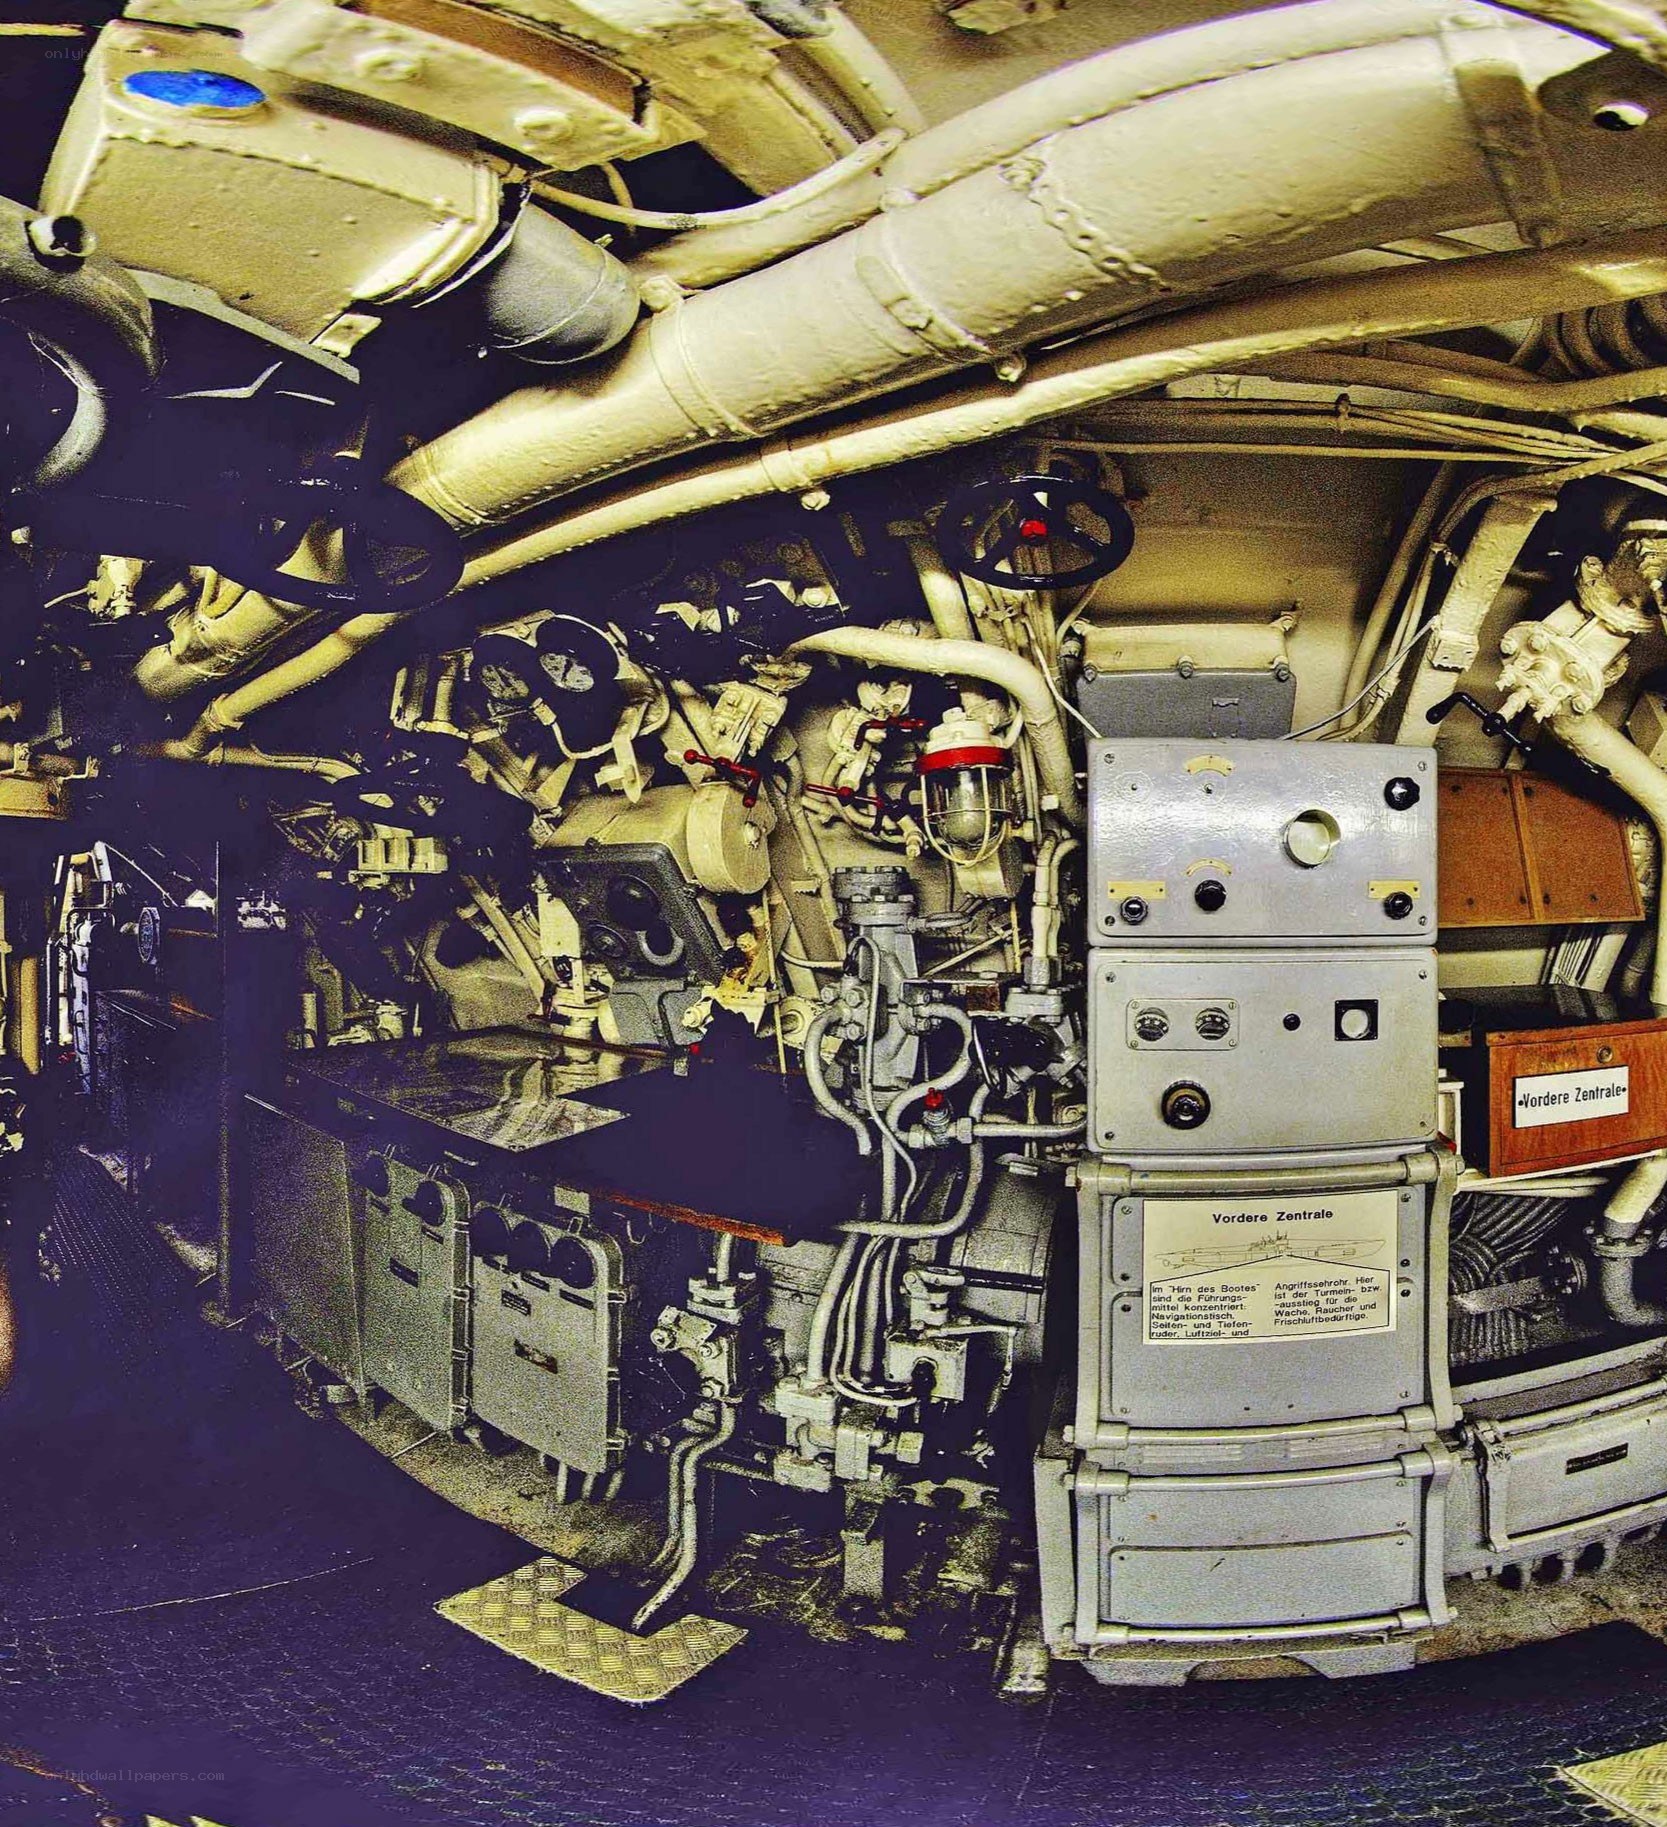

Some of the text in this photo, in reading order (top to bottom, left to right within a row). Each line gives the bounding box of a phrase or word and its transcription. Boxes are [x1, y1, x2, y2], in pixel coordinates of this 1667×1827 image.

[1523, 1082, 1622, 1108] Vordere Zentrale
[1212, 1209, 1333, 1224] Vordere Zentrale
[1198, 1294, 1247, 1302] Führungs-
[1275, 1292, 1285, 1300] ist
[1292, 1291, 1308, 1299] der
[1315, 1288, 1355, 1296] Turmein-
[1275, 1299, 1320, 1308] -ausstieg
[1316, 1306, 1354, 1314] Raucher
[1360, 1302, 1376, 1310] und
